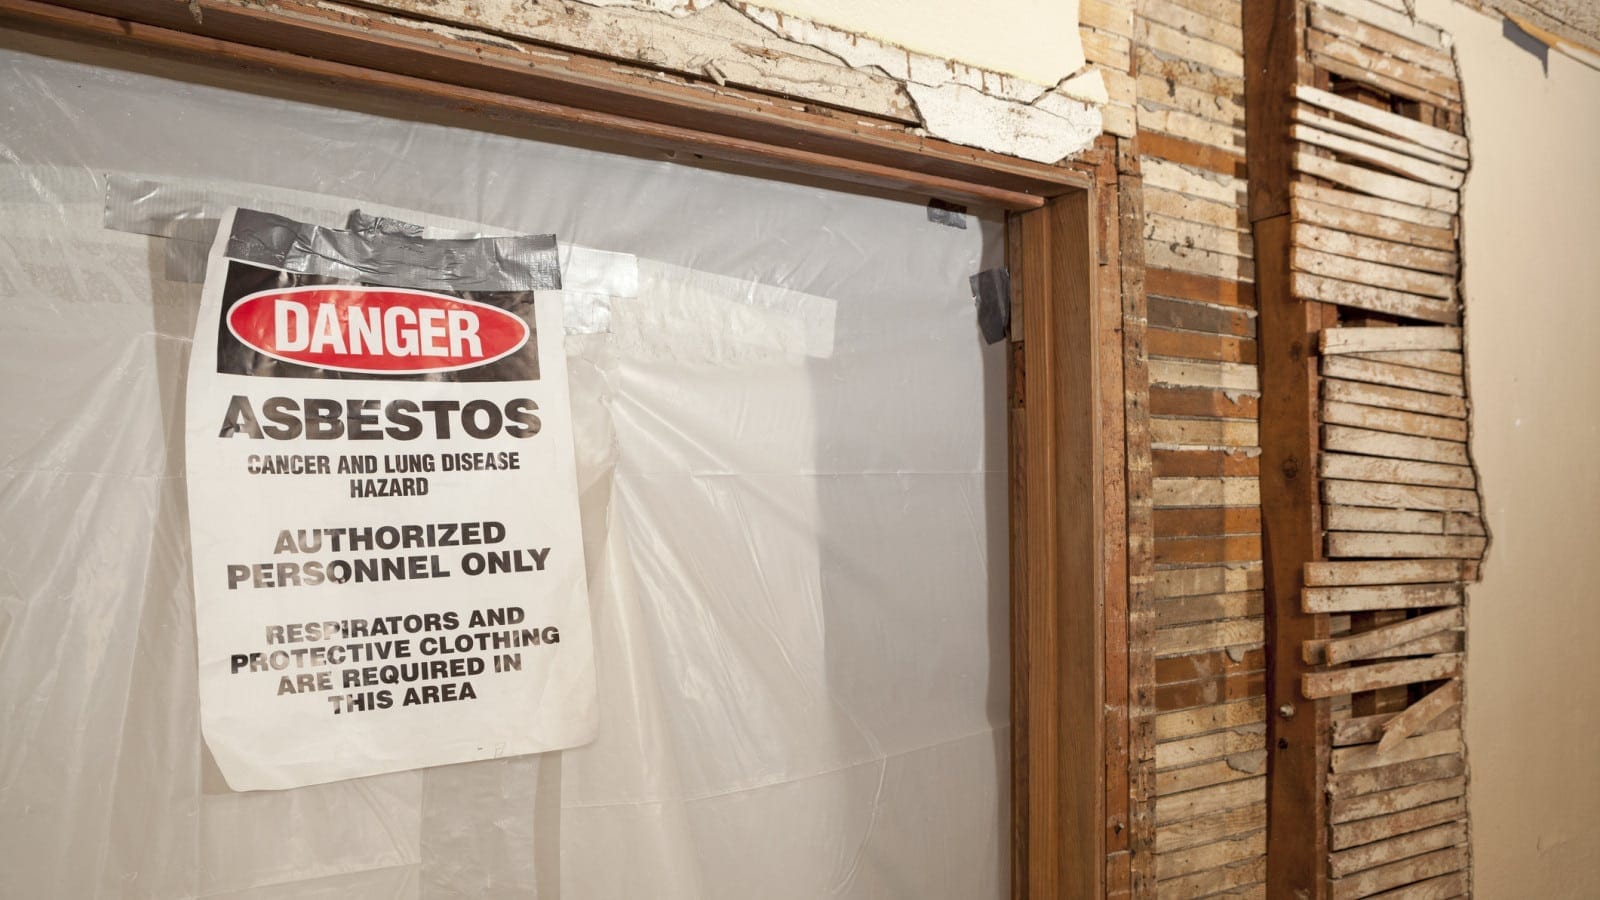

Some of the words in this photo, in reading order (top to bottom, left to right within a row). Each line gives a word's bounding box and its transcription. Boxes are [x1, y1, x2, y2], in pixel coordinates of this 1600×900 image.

[274, 299, 483, 357] DANGER
[219, 395, 542, 440] ASBESTOS
[247, 454, 331, 474] CANCER
[337, 455, 378, 474] AND
[384, 454, 435, 472] LUNG
[442, 451, 520, 471] DISEASE
[350, 477, 429, 498] HAZARD
[273, 521, 505, 554] AUTHORIZED
[227, 554, 450, 590] PERSONNEL
[462, 547, 551, 576] ONLY
[266, 611, 459, 645] RESPIRATORS
[468, 607, 525, 626] AND
[231, 640, 411, 674] PROTECTIVE
[420, 626, 560, 656] CLOTHING
[277, 671, 333, 695] ARE
[343, 657, 484, 688] REQUIRED
[495, 653, 522, 673] IN
[328, 689, 393, 714] THIS
[402, 682, 477, 706] AREA
